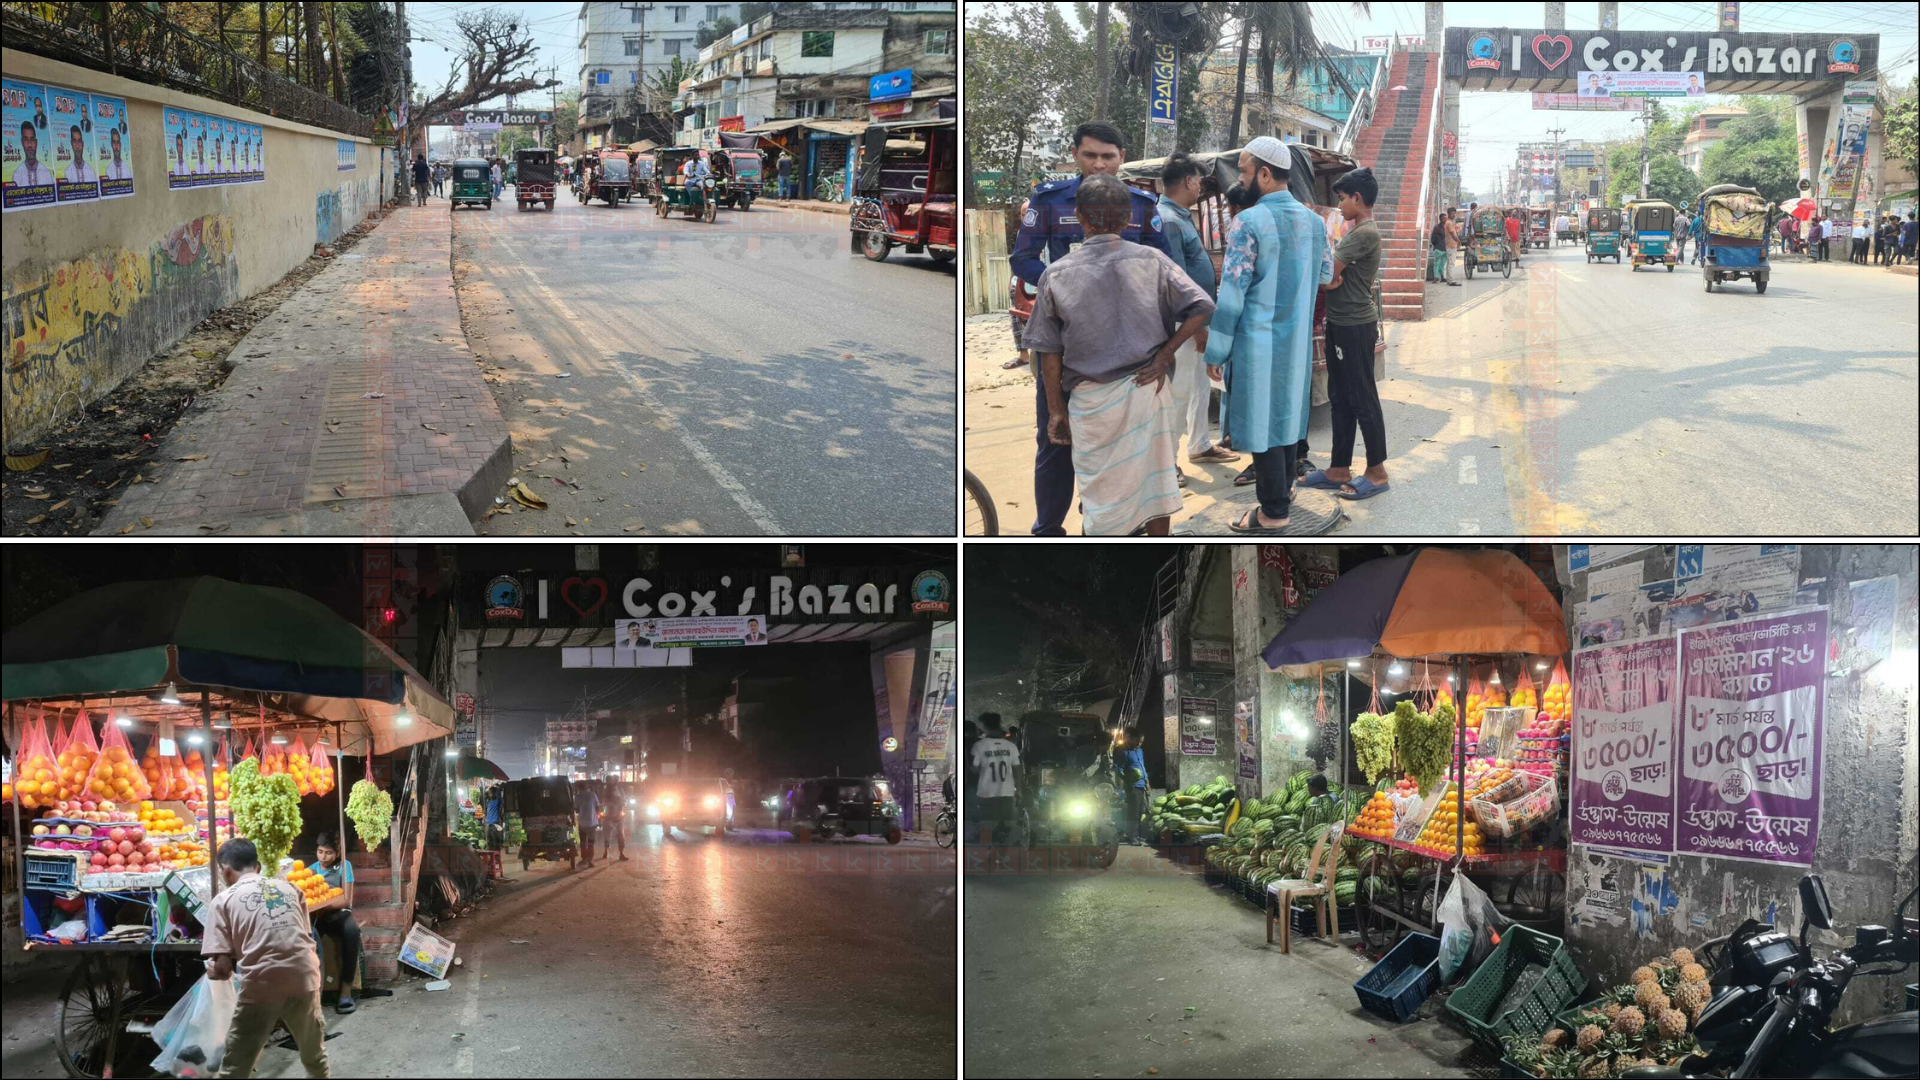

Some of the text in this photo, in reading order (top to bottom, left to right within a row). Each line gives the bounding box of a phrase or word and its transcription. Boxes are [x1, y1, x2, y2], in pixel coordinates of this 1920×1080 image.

[1470, 60, 1496, 68] CoxDA
[1512, 35, 1816, 73] I Cox's Bazar
[466, 112, 537, 124] Cox's Bazar
[538, 575, 898, 618] I Cox's Bazar
[488, 609, 518, 617] CoxDA
[1716, 707, 1740, 725] মার্চ
[1742, 705, 1775, 724] পর্যন্ত
[1582, 728, 1667, 770] ৩৫০০/-
[1692, 719, 1808, 768] ৩৫০০/-
[989, 761, 1007, 783] 10
[1630, 761, 1667, 783] ছাড়!
[1755, 757, 1808, 783] ছাড়!
[1582, 828, 1662, 845] ০৯৬৬৬৭৭৫৫৬৬
[1690, 836, 1799, 856] ০৯৬৬৬৭৭৫৫৬৬
